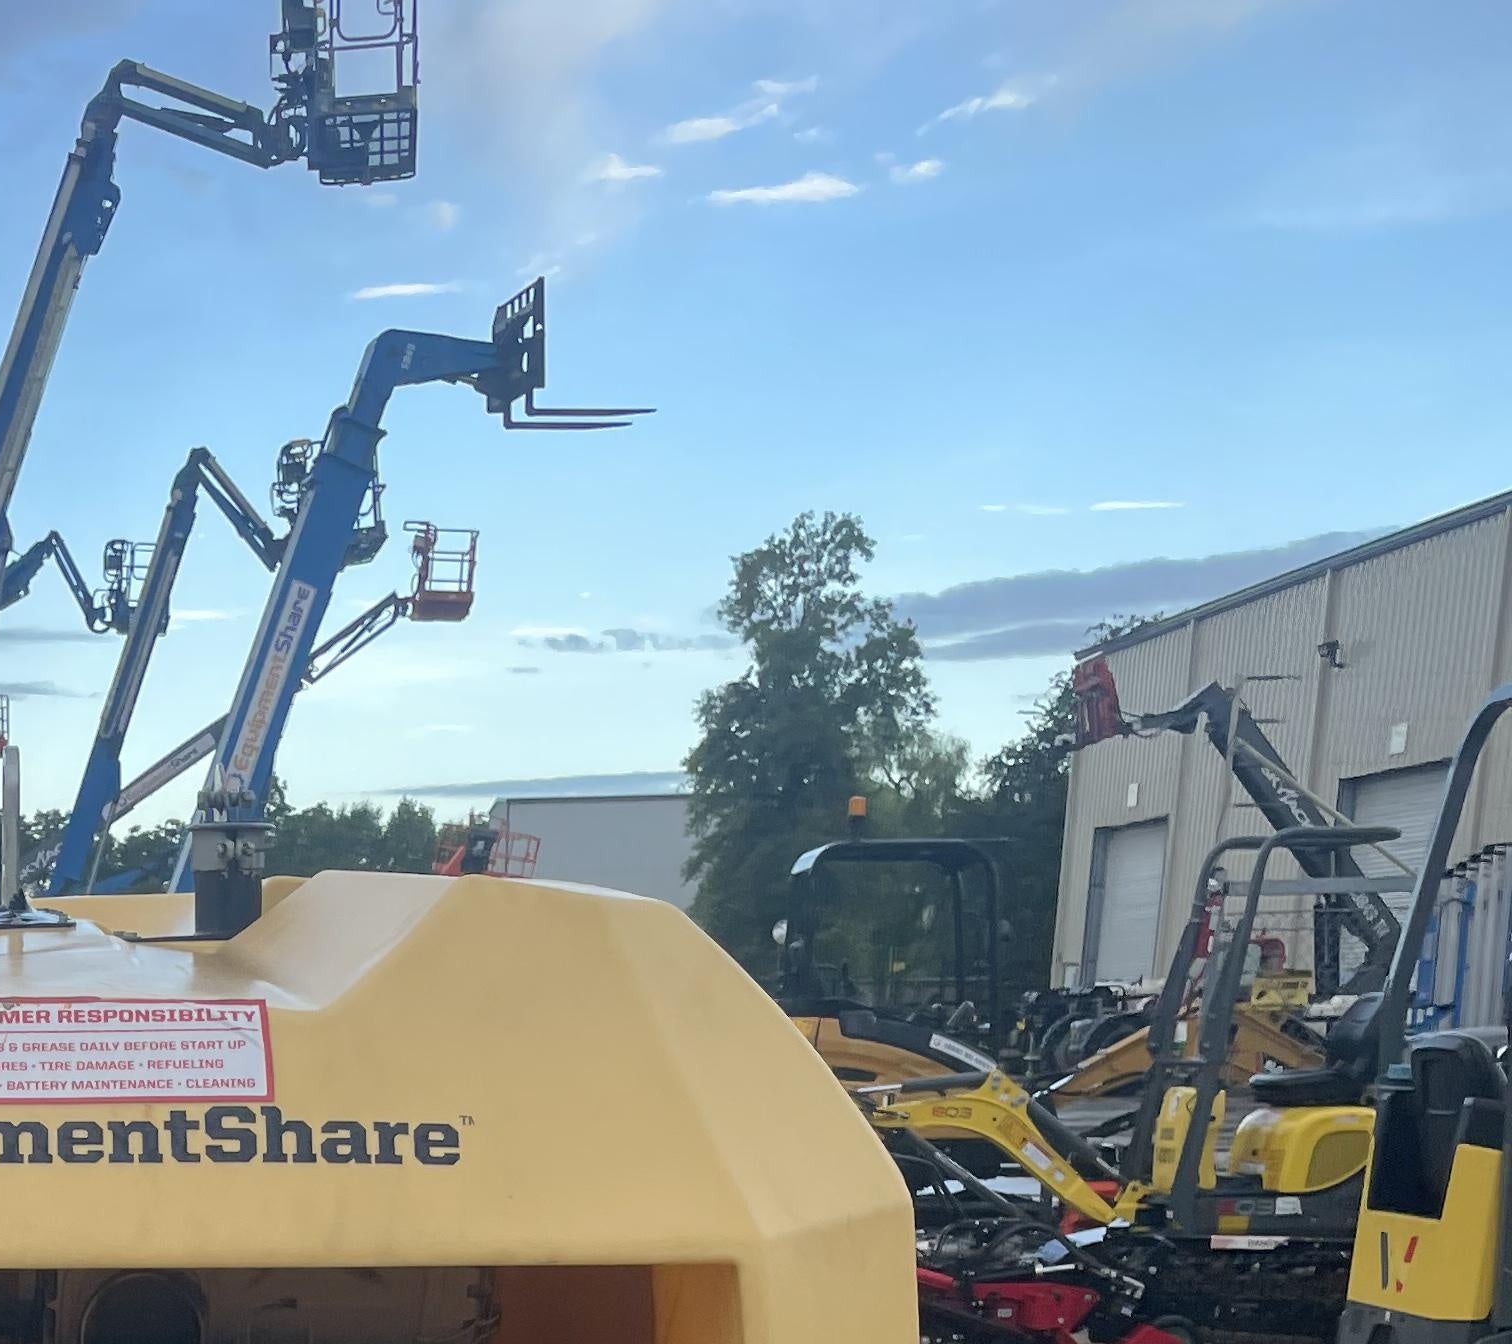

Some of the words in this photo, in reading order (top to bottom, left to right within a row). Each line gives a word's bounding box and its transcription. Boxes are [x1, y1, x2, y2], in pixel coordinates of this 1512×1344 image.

[57, 1007, 256, 1025] RESPONSIBILITY
[8, 1042, 18, 1052] &
[22, 1042, 75, 1052] GREASE
[79, 1041, 120, 1052] DAILY
[124, 1041, 177, 1051] BEFORE
[180, 1040, 224, 1050] START
[227, 1039, 246, 1050] UP
[39, 1061, 72, 1071] TIRE
[76, 1060, 135, 1071] DAMAGE
[147, 1058, 224, 1070] REFUELING
[6, 1080, 69, 1091] BATTERY
[71, 1079, 174, 1090] MAINTENANCE
[185, 1078, 256, 1089] CLEANING
